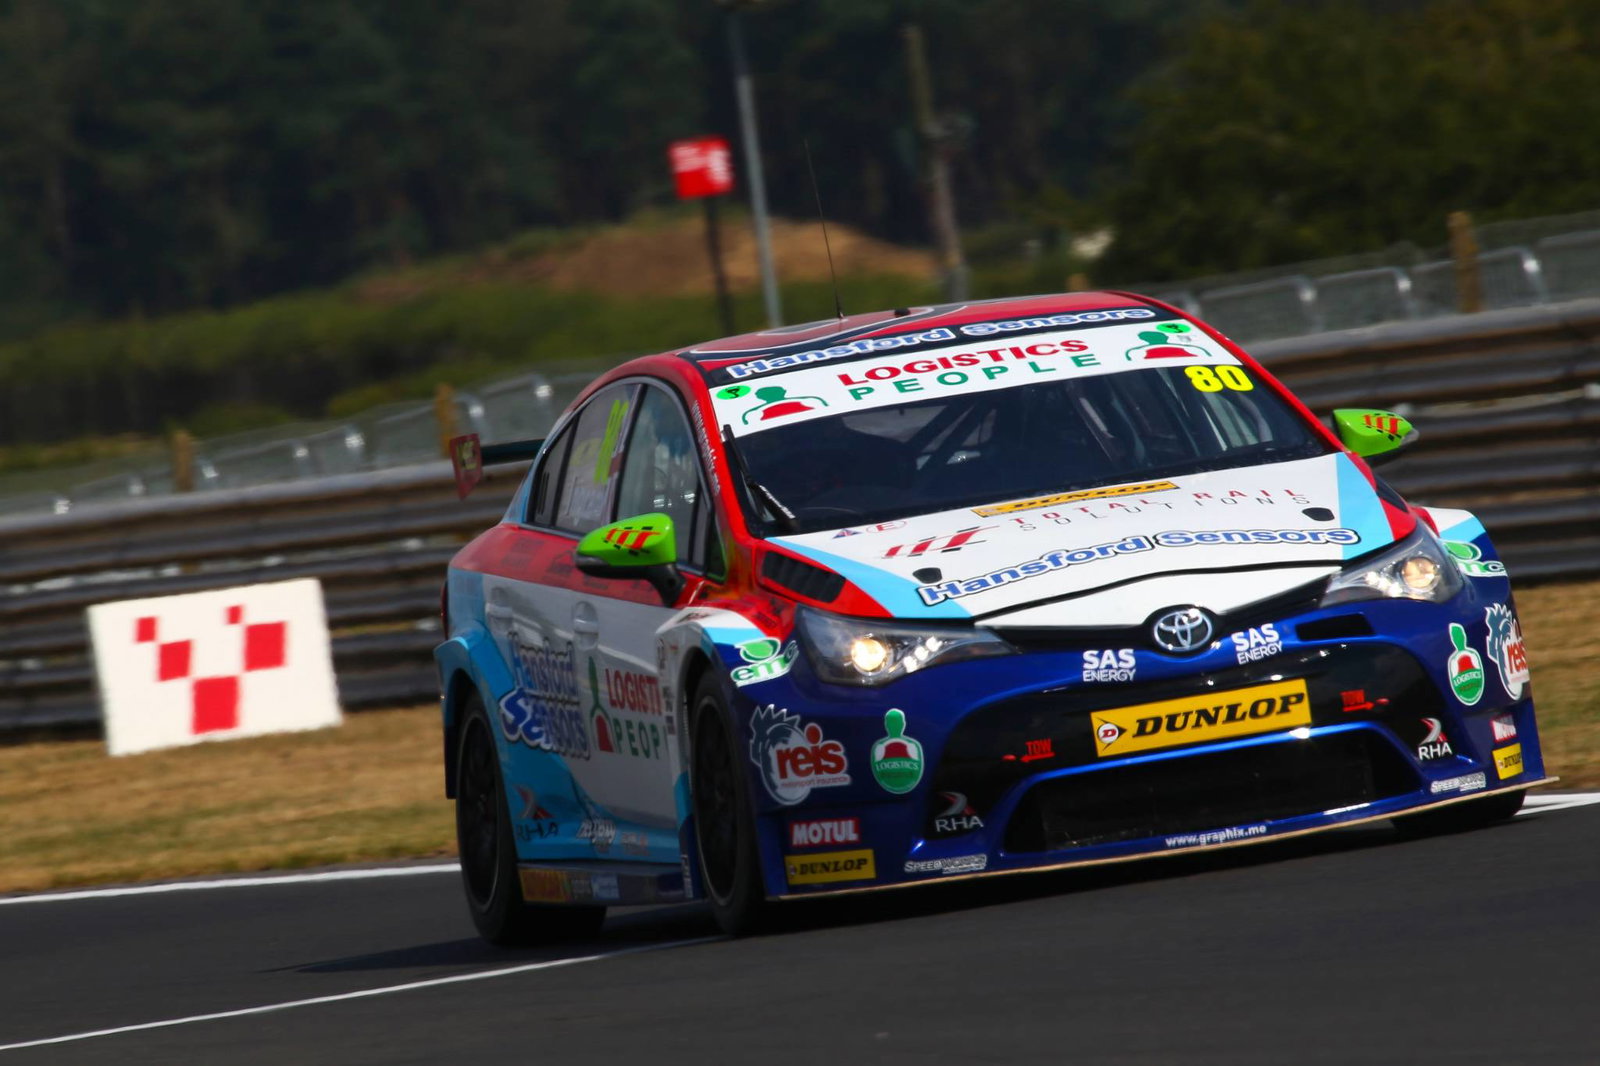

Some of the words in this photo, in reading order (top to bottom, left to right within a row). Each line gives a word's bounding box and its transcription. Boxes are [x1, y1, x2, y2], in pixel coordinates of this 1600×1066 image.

[726, 328, 954, 378] Hansford
[960, 309, 1156, 336] Sensors
[837, 340, 1089, 386] LOGISTICS
[848, 354, 1101, 401] PEOPLE
[1184, 365, 1254, 392] 80
[1008, 499, 1158, 524] TOTAL
[1192, 488, 1305, 500] RAIL
[1021, 496, 1310, 532] SOLUTIONS
[919, 537, 1152, 604] Hansford
[1157, 529, 1359, 546] Sensors
[1231, 623, 1280, 651] SAS
[1083, 648, 1136, 669] SAS
[1237, 641, 1283, 665] ENERGY
[1083, 669, 1136, 682] ENERGY
[1132, 692, 1305, 738] DUNLOP
[776, 722, 846, 779] reis
[1418, 742, 1453, 760] RHA
[876, 760, 919, 771] LOGISTICS
[792, 820, 859, 845] MOTUL
[935, 816, 984, 832] RHA
[1165, 825, 1267, 846] www.graphix.me
[800, 858, 868, 875] DUNLOP
